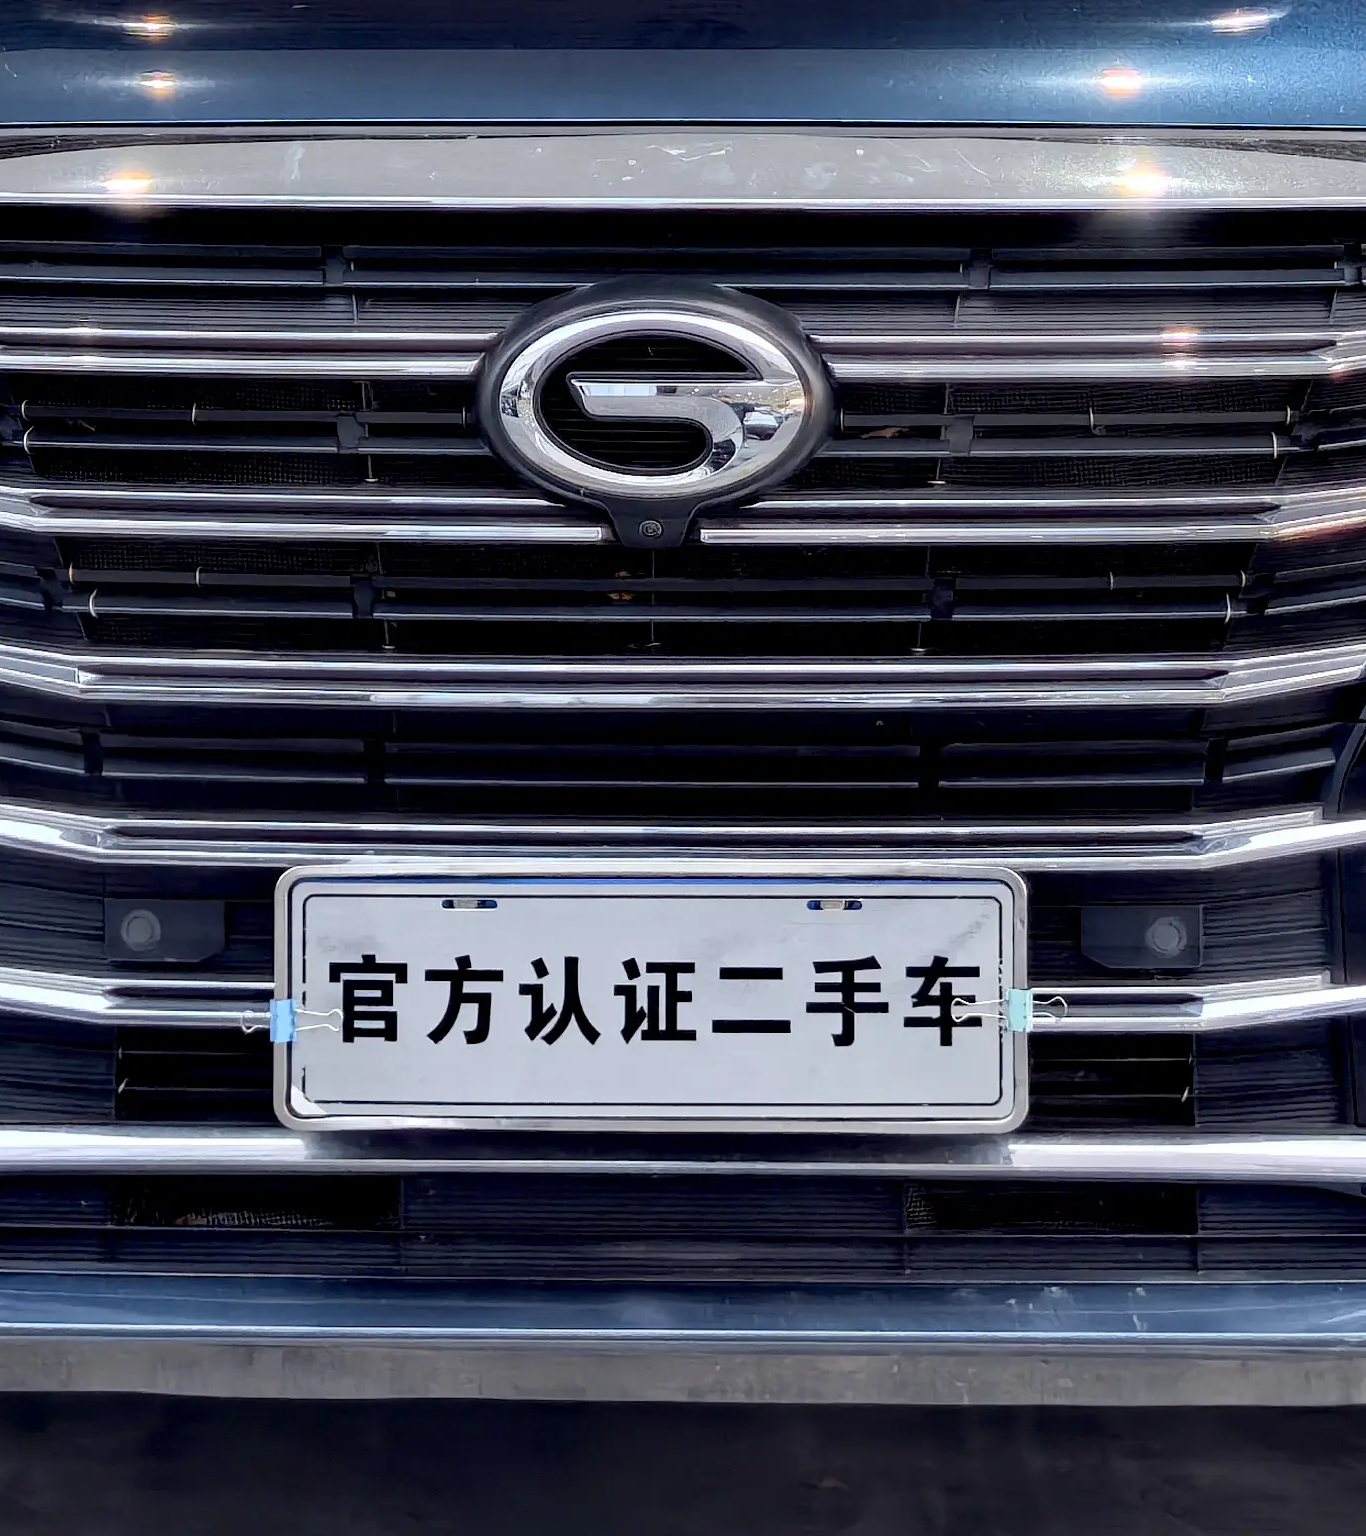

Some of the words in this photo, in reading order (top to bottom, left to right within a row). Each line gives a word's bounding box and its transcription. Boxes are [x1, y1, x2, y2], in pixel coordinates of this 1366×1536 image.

[327, 953, 983, 1047] 官方认证二手车
